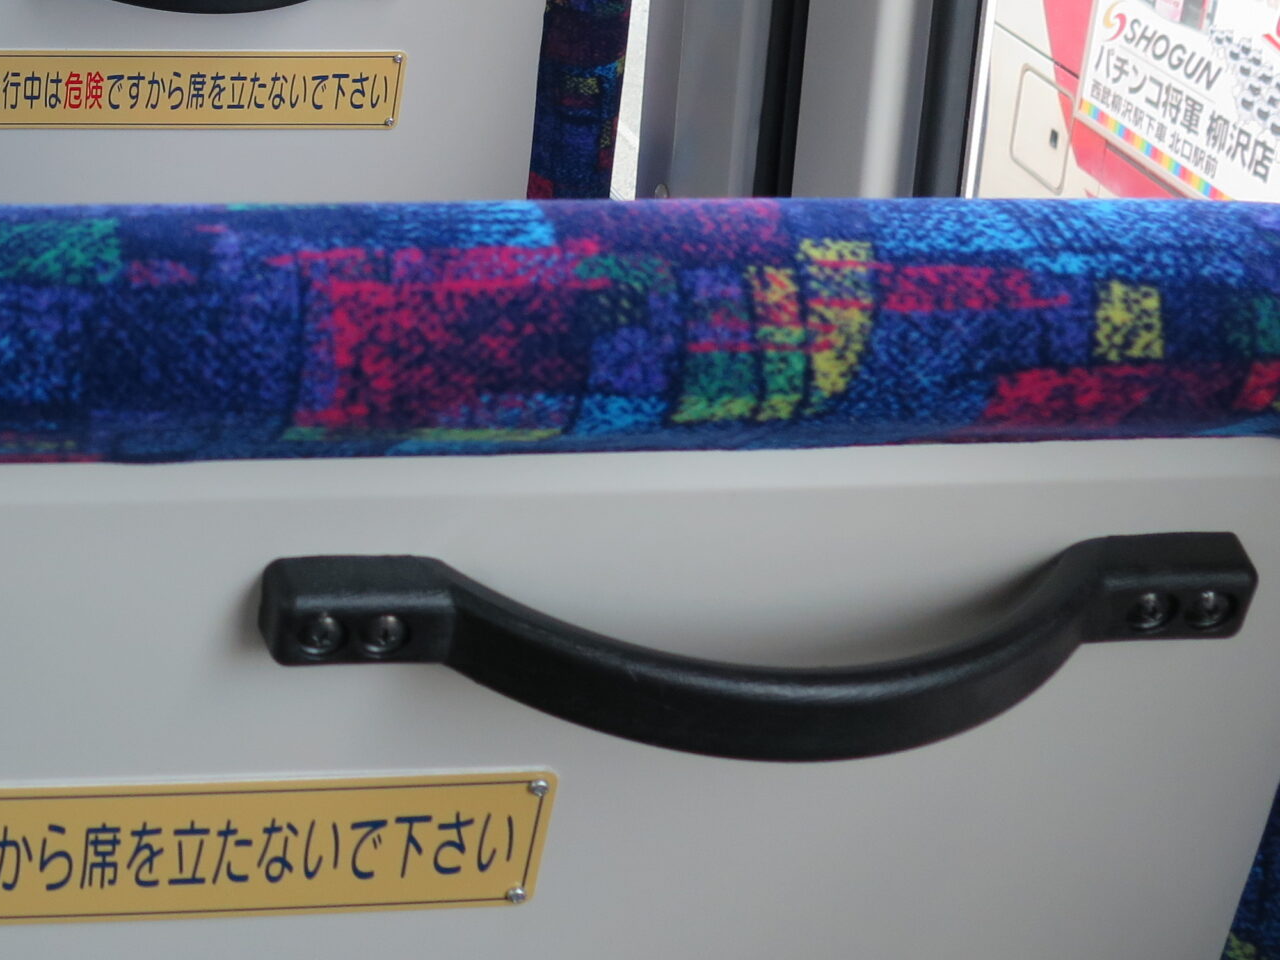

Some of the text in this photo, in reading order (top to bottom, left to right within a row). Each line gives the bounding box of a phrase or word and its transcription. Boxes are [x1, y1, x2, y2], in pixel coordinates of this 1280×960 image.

[1123, 18, 1222, 90] SHOGUN
[1090, 77, 1219, 180] 西武柳沢駅下車 北口駅前
[1094, 45, 1275, 183] パチンコ将軍 柳沢店
